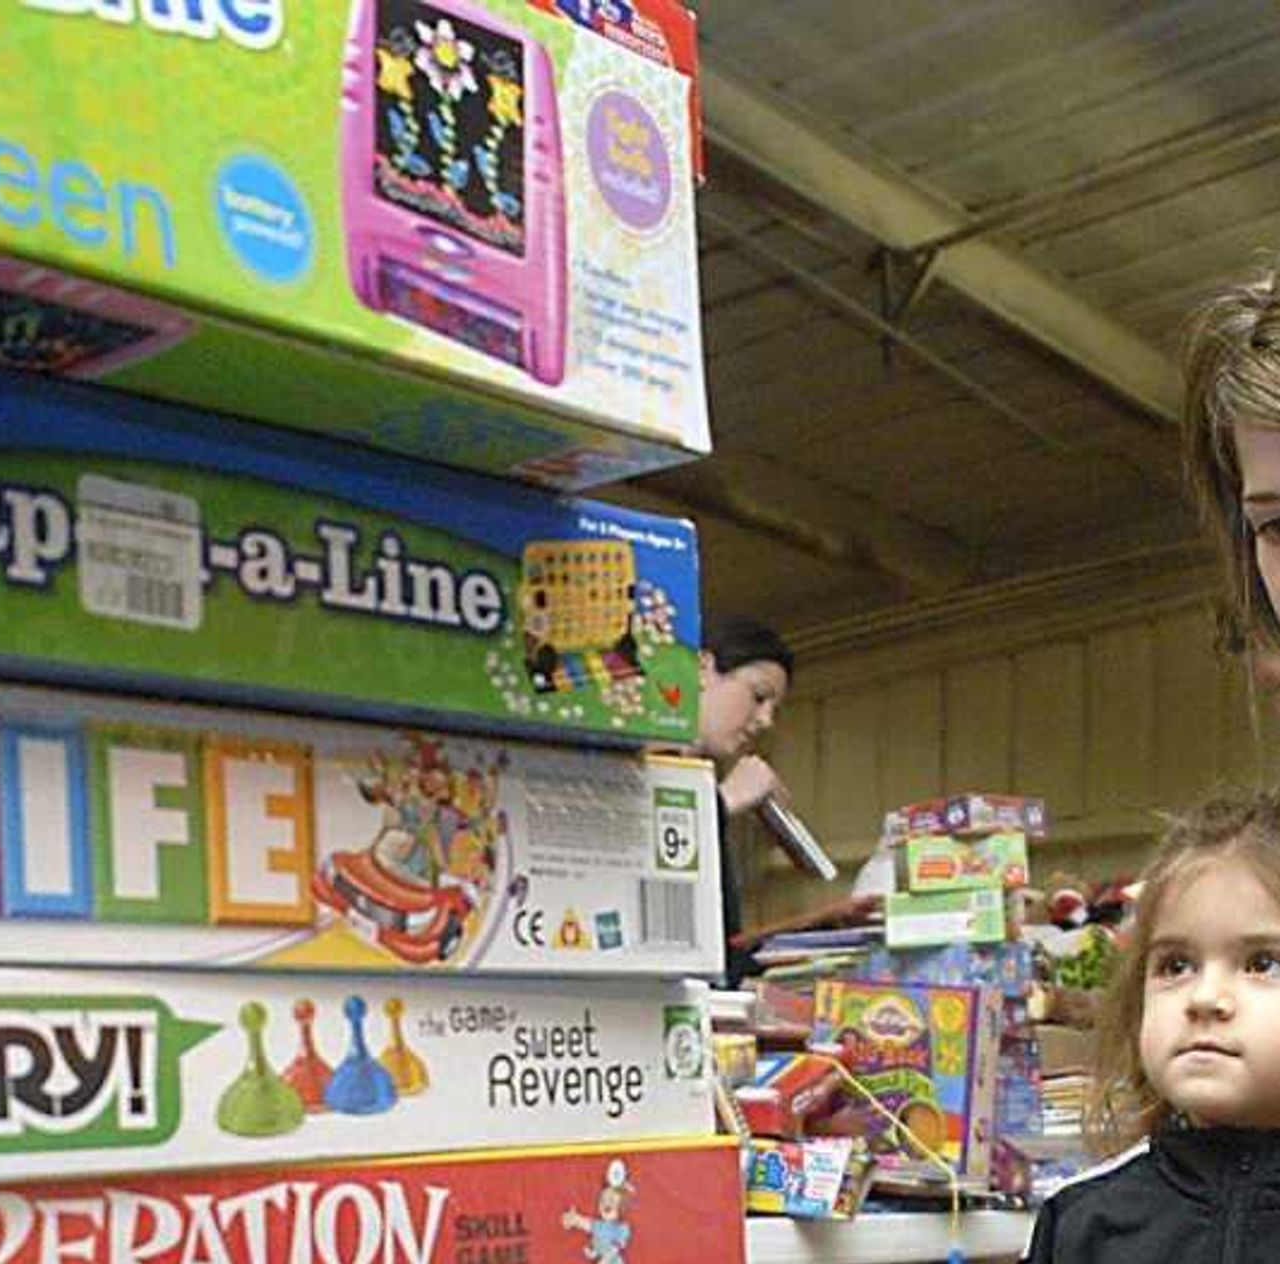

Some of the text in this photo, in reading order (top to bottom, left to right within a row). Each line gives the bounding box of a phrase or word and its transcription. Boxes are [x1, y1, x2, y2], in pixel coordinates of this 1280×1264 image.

[513, 1007, 599, 1059] sweet
[488, 1053, 643, 1118] Revenge
[454, 1212, 528, 1241] SKILL
